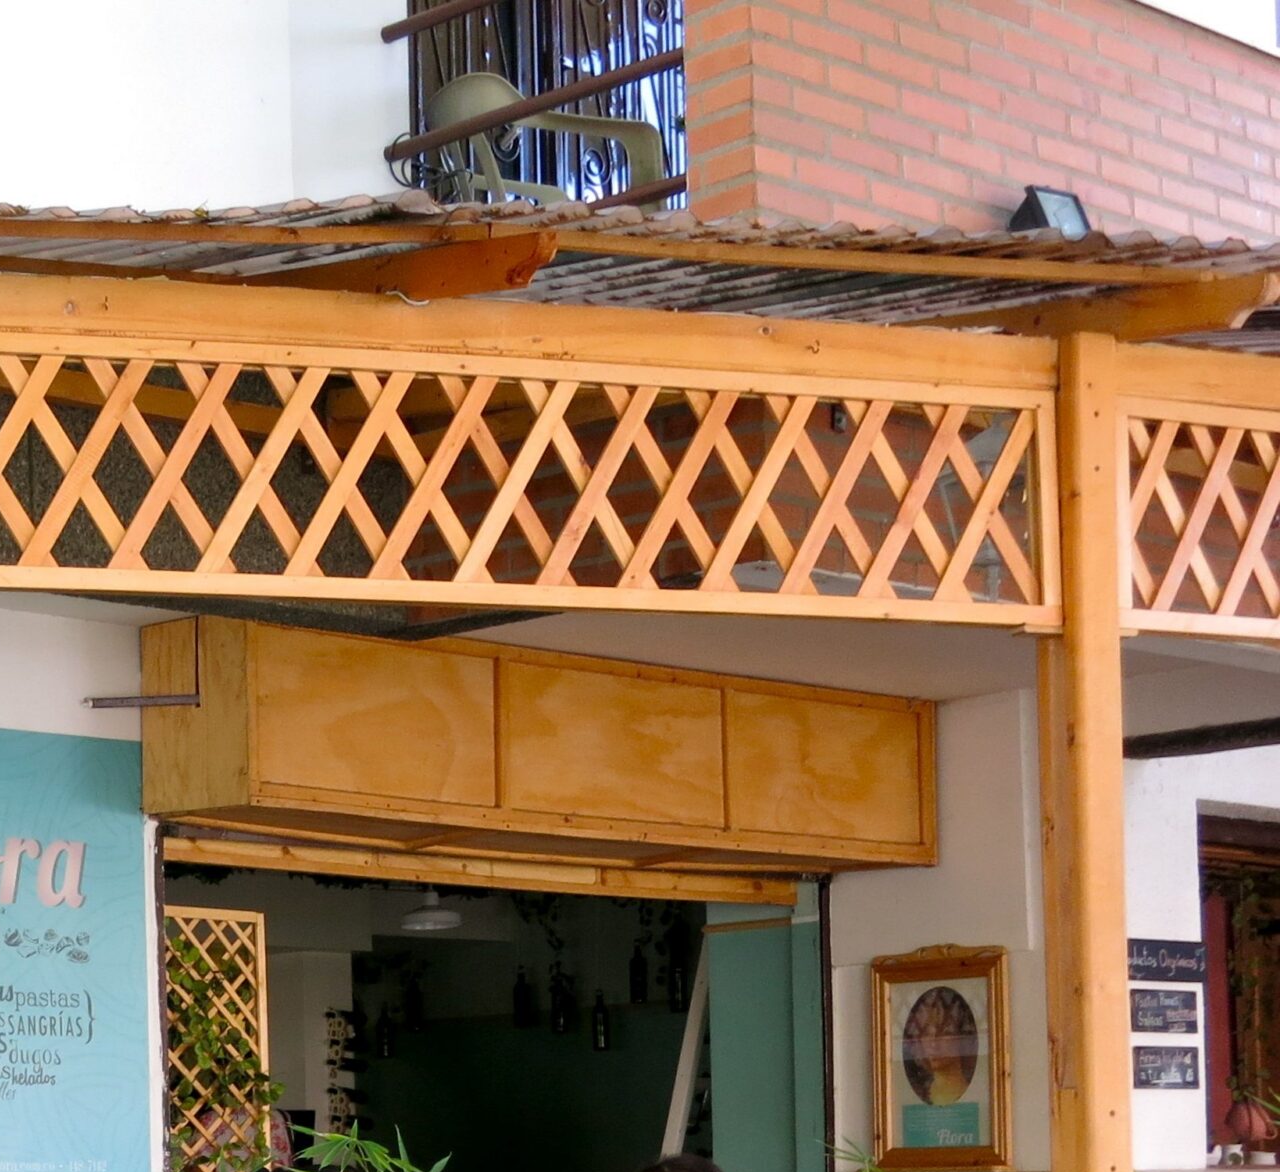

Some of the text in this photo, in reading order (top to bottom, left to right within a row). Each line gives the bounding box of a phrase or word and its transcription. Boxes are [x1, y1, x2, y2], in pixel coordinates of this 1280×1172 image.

[14, 990, 81, 1012] pastas
[7, 1011, 84, 1038] SANGRÍAS
[11, 1066, 57, 1087] helados
